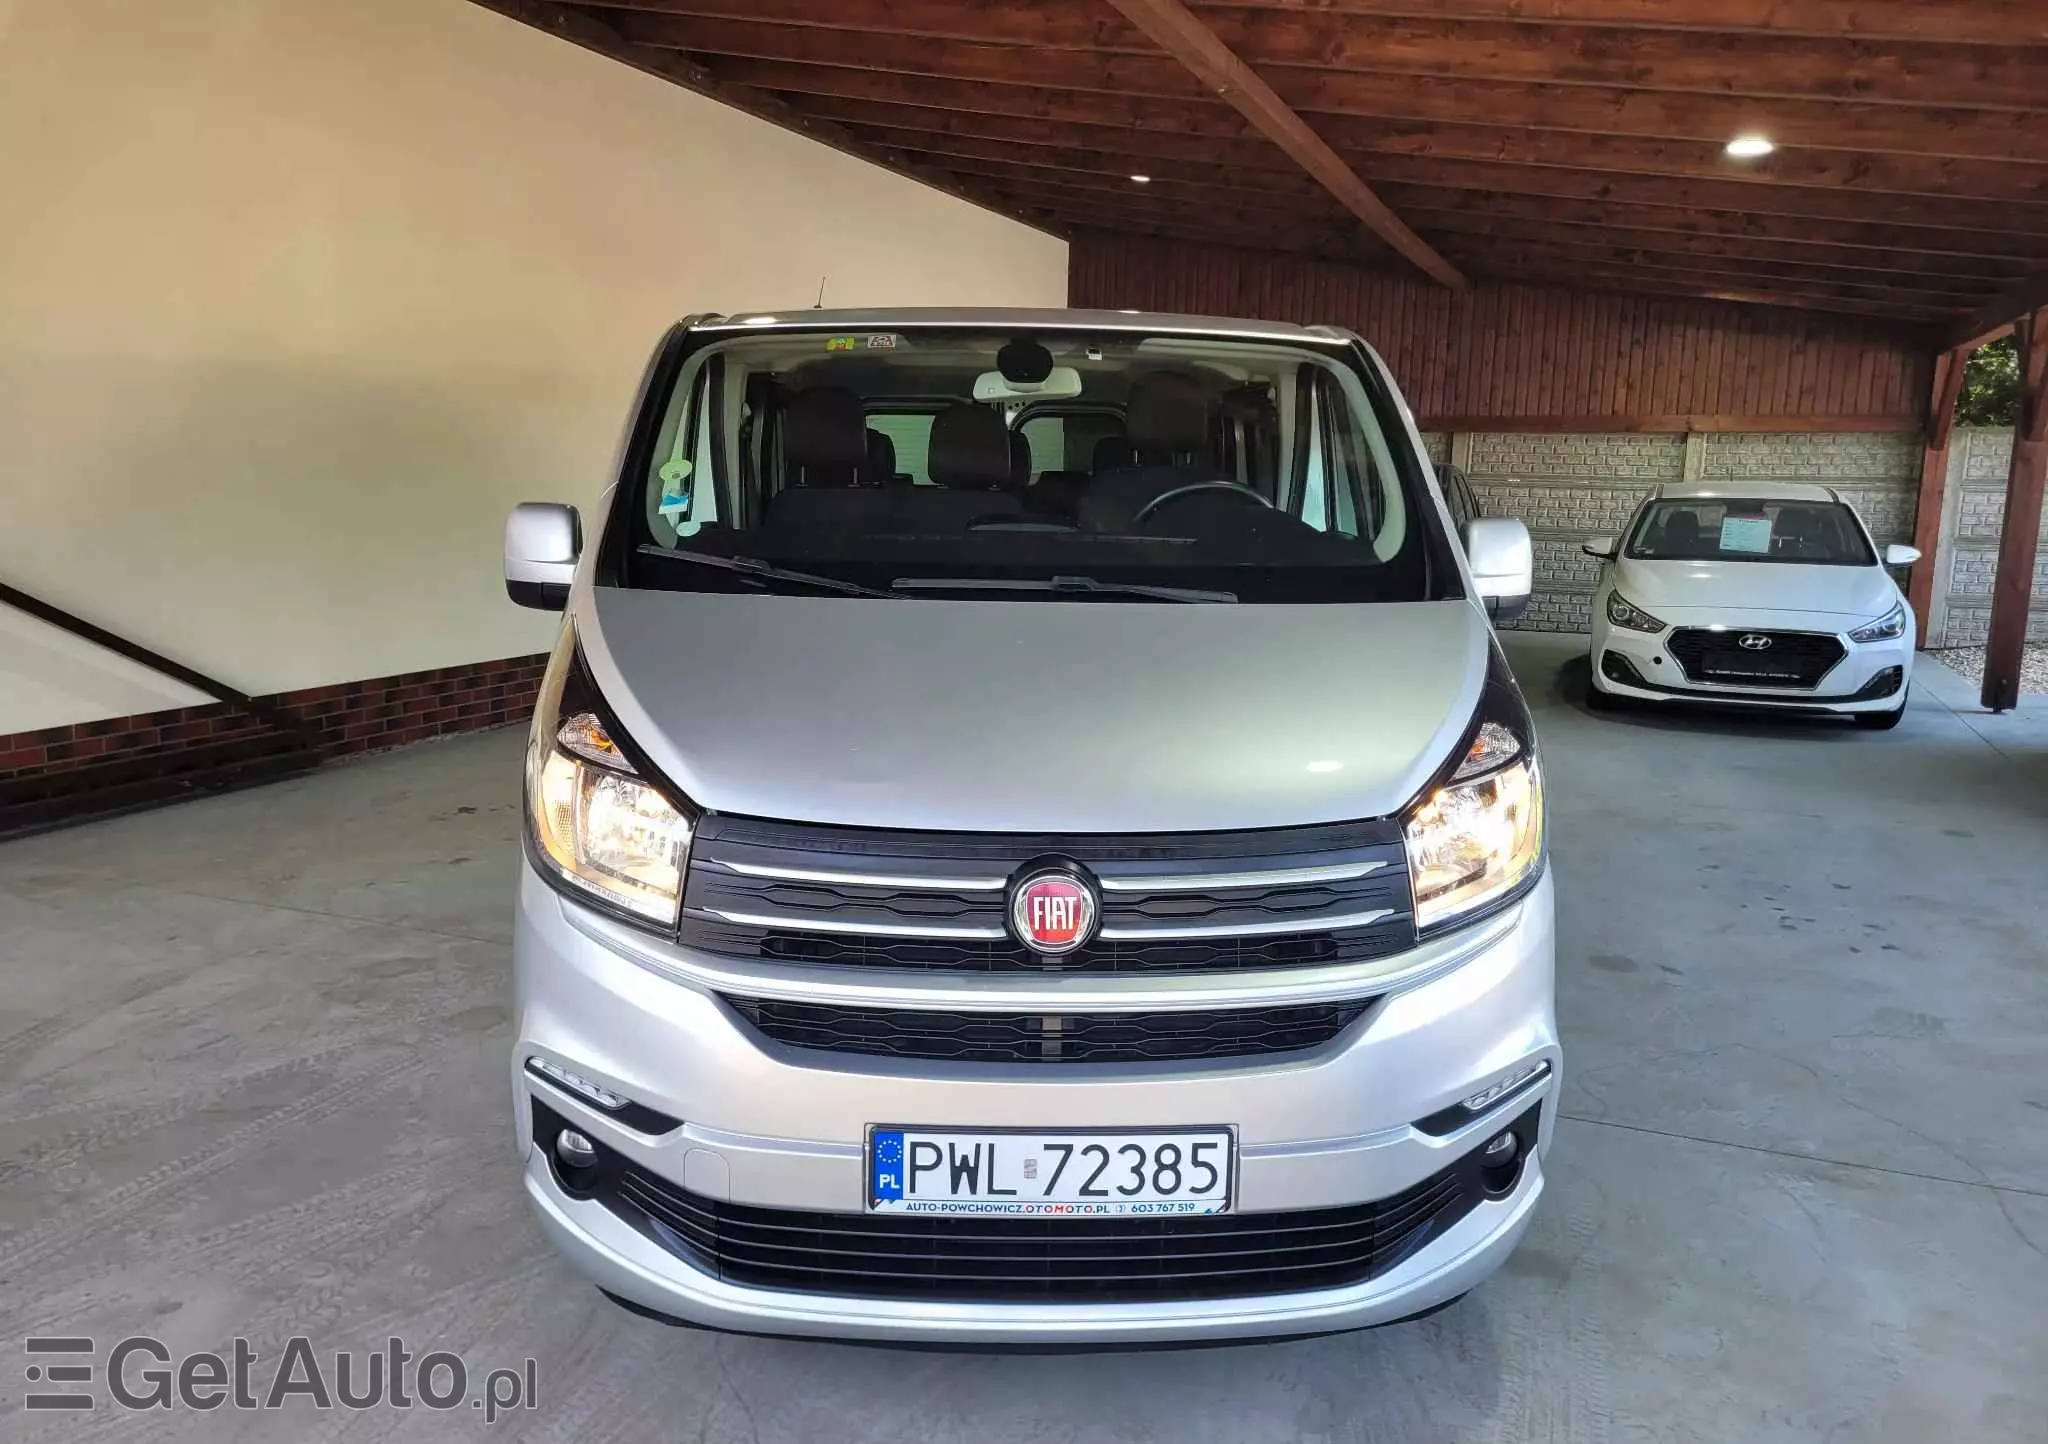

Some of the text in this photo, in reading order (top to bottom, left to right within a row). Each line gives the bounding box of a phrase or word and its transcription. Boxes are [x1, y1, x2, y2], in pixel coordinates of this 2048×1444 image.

[1033, 896, 1077, 931] FIAT
[879, 1173, 900, 1189] PL
[908, 1141, 1219, 1197] PWL 72385
[906, 1202, 1196, 1215] AUTO-POWCHOWICZ.OTOMOTO.PL 603 767 519
